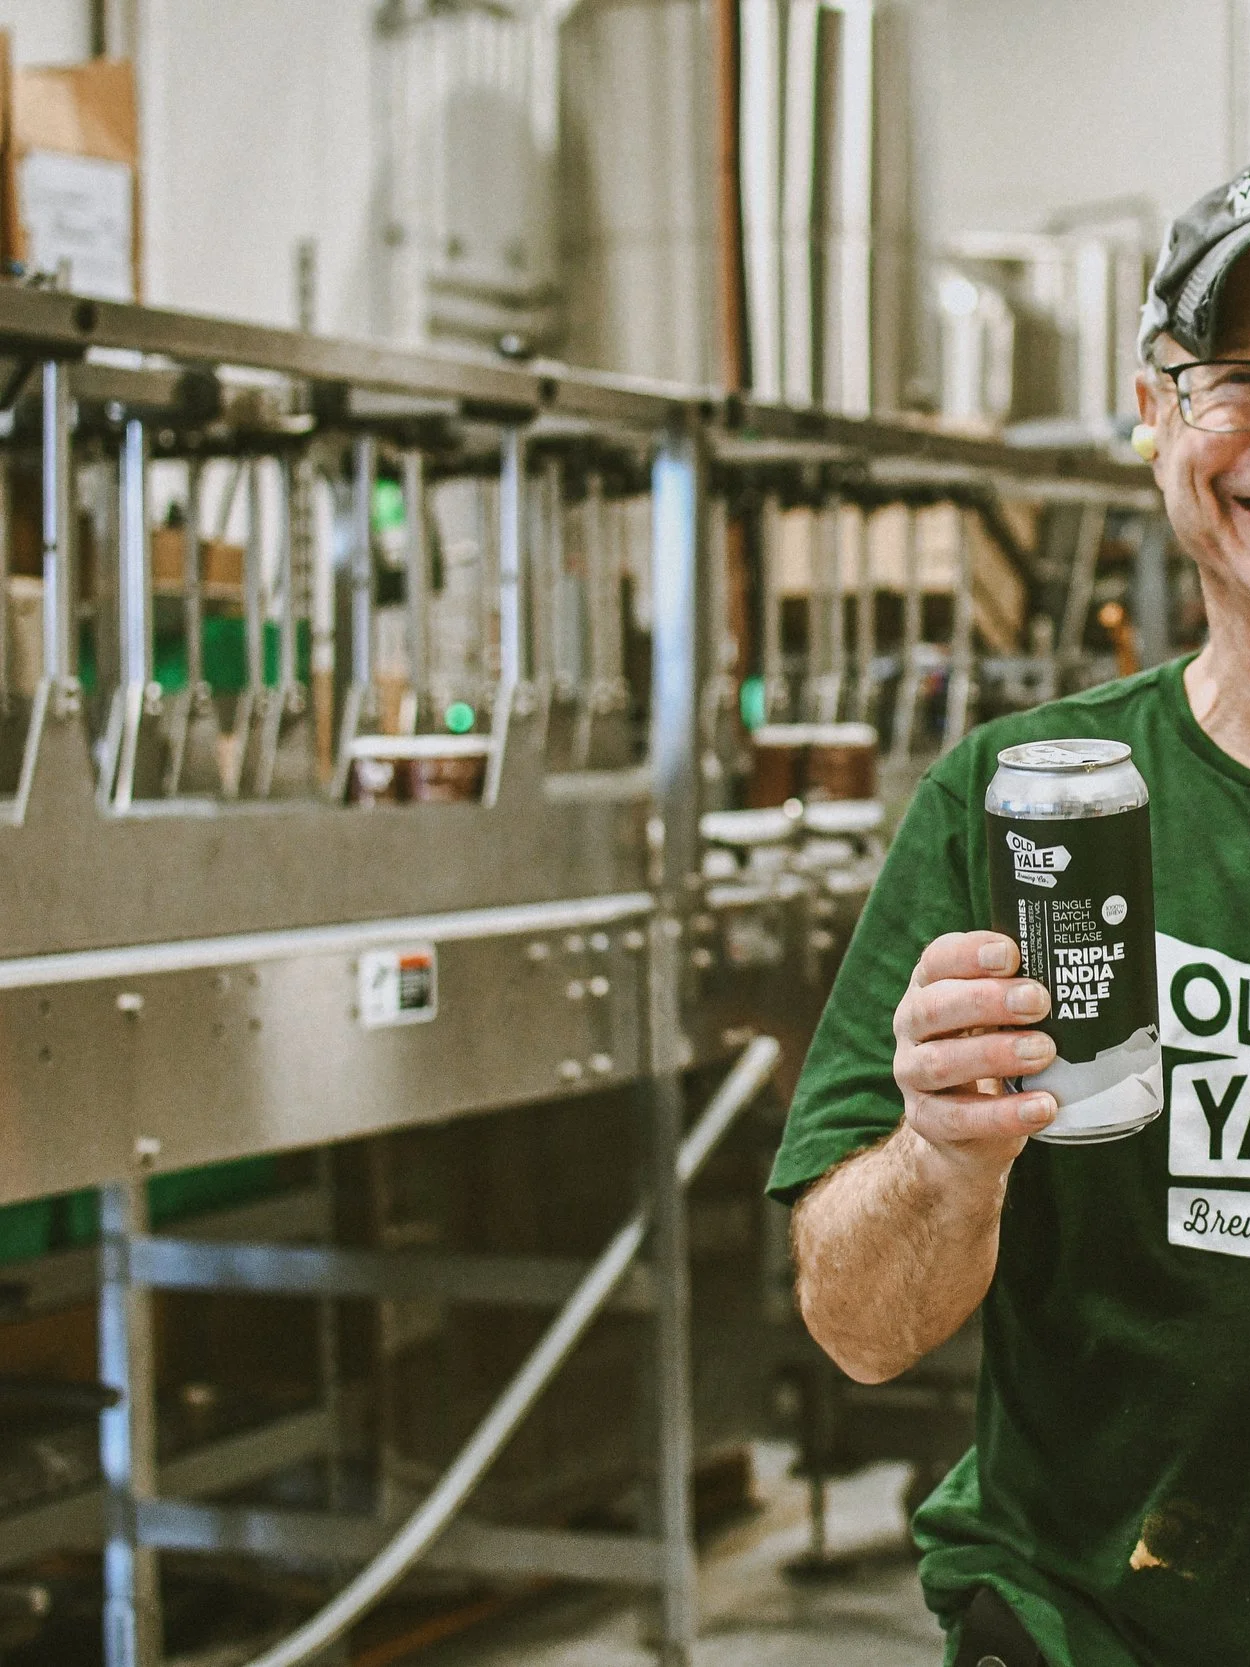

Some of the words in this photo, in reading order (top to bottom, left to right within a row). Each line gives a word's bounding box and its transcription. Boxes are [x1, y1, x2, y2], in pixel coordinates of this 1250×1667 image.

[1012, 836, 1033, 852] OLD
[1016, 850, 1055, 868] YALE
[1052, 899, 1092, 910] SINGLE
[1018, 899, 1027, 938] SERIES
[1053, 911, 1090, 922] BATCH
[1053, 921, 1097, 933] LIMITED
[1054, 931, 1103, 943] RELEASE
[1021, 941, 1029, 978] LAZER
[1053, 942, 1125, 966] TRIPLE
[1056, 963, 1115, 984] INDIA
[1056, 981, 1110, 1002] PALE
[1058, 1001, 1099, 1019] ALE
